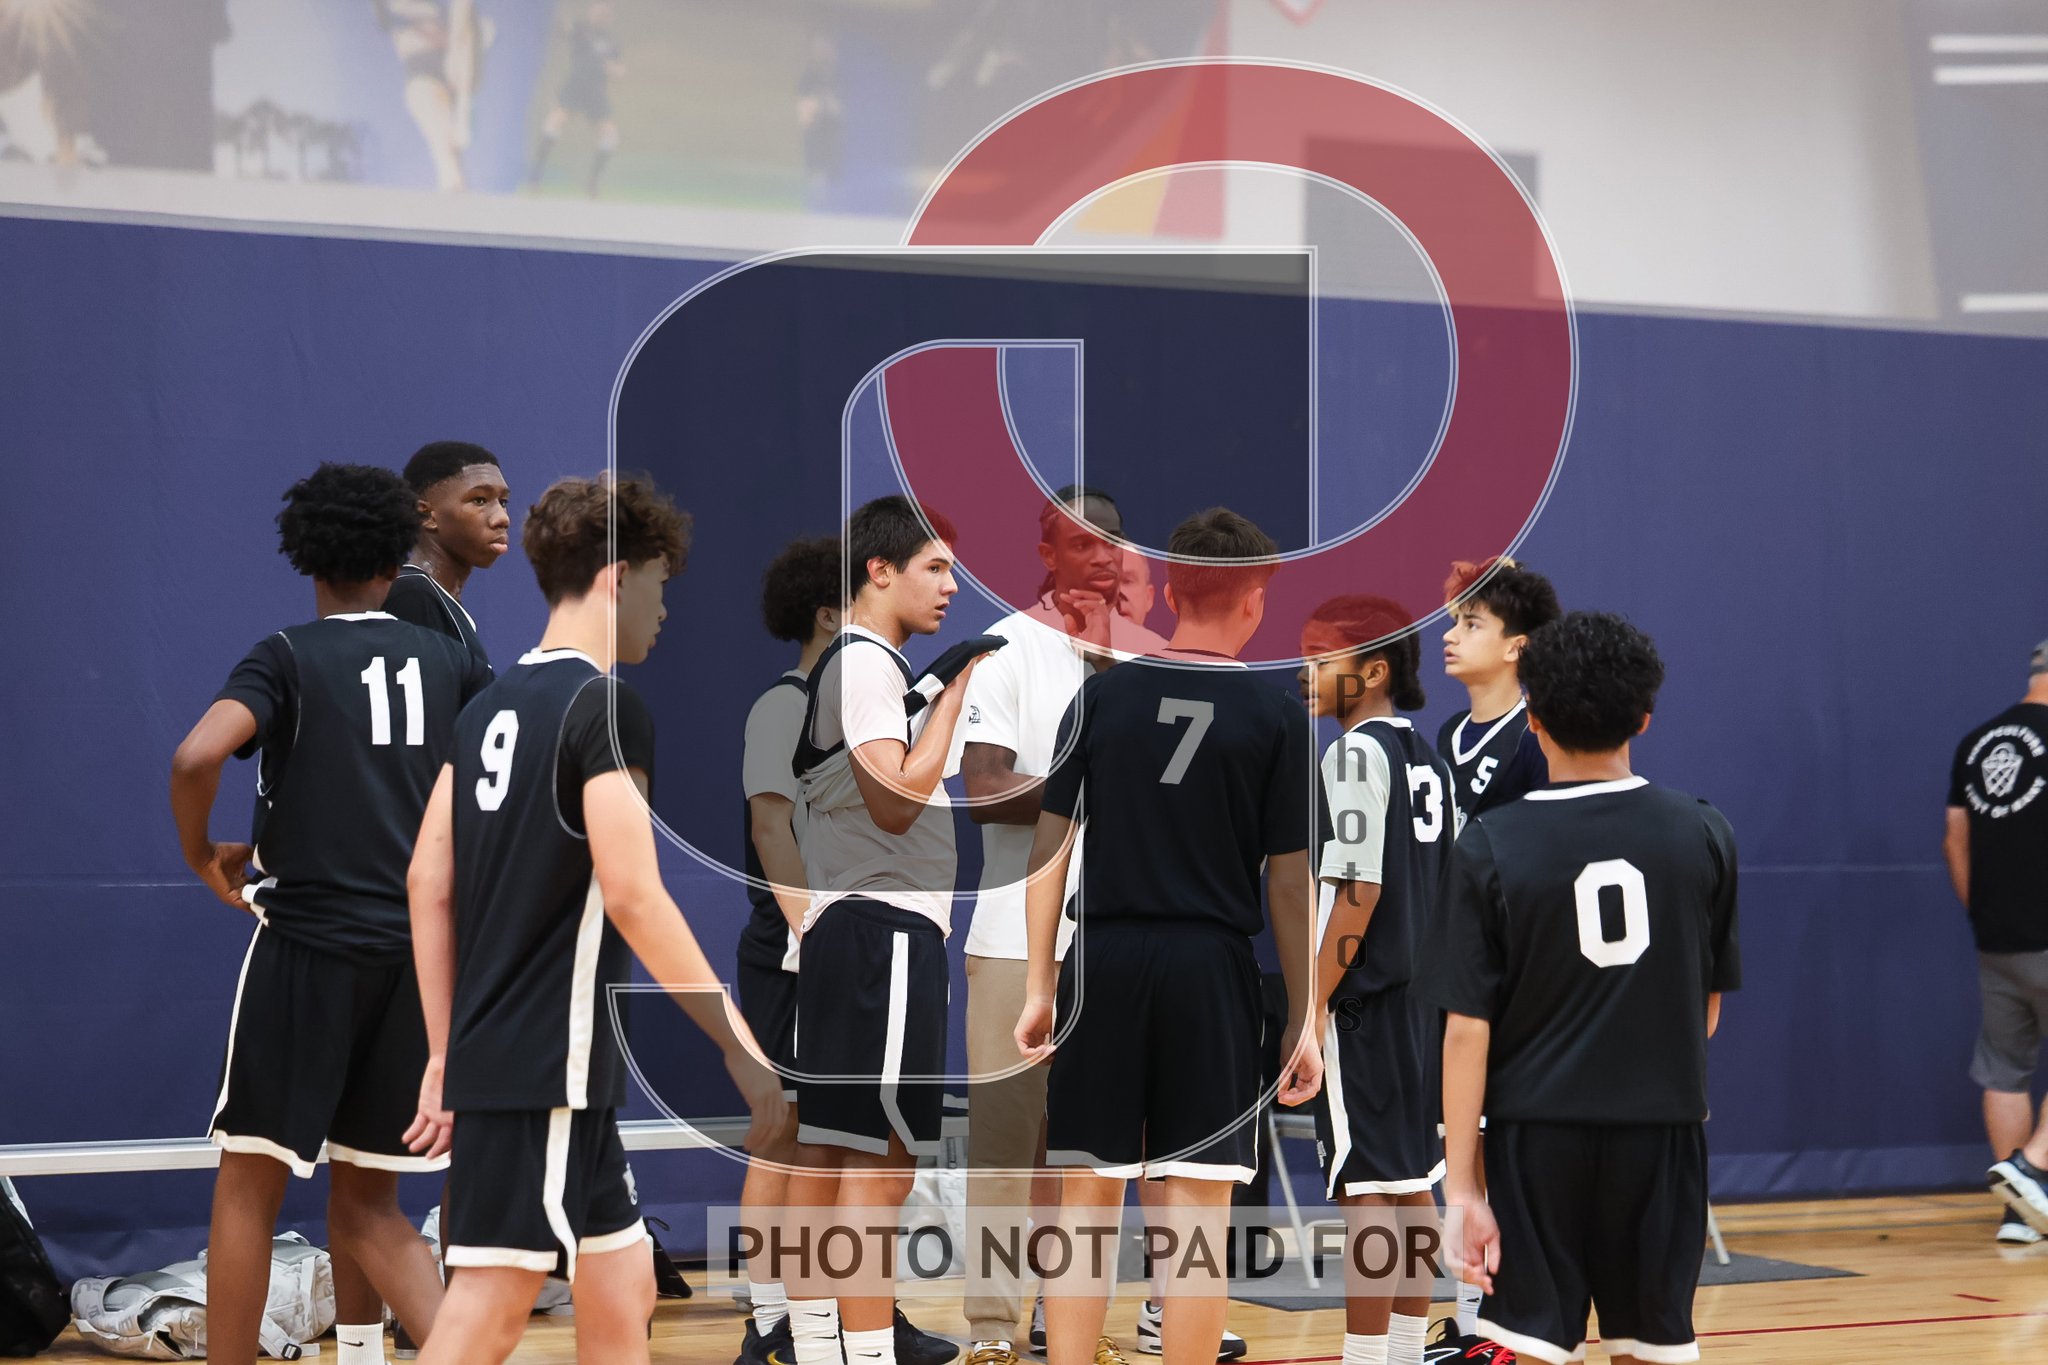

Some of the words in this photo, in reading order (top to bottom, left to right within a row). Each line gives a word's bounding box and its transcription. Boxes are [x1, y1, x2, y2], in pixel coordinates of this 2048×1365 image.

[360, 656, 425, 746] 11
[1156, 697, 1215, 785] 7
[475, 709, 520, 812] 9
[1405, 763, 1443, 842] 3
[1469, 755, 1499, 795] 5
[1573, 858, 1651, 969] 0
